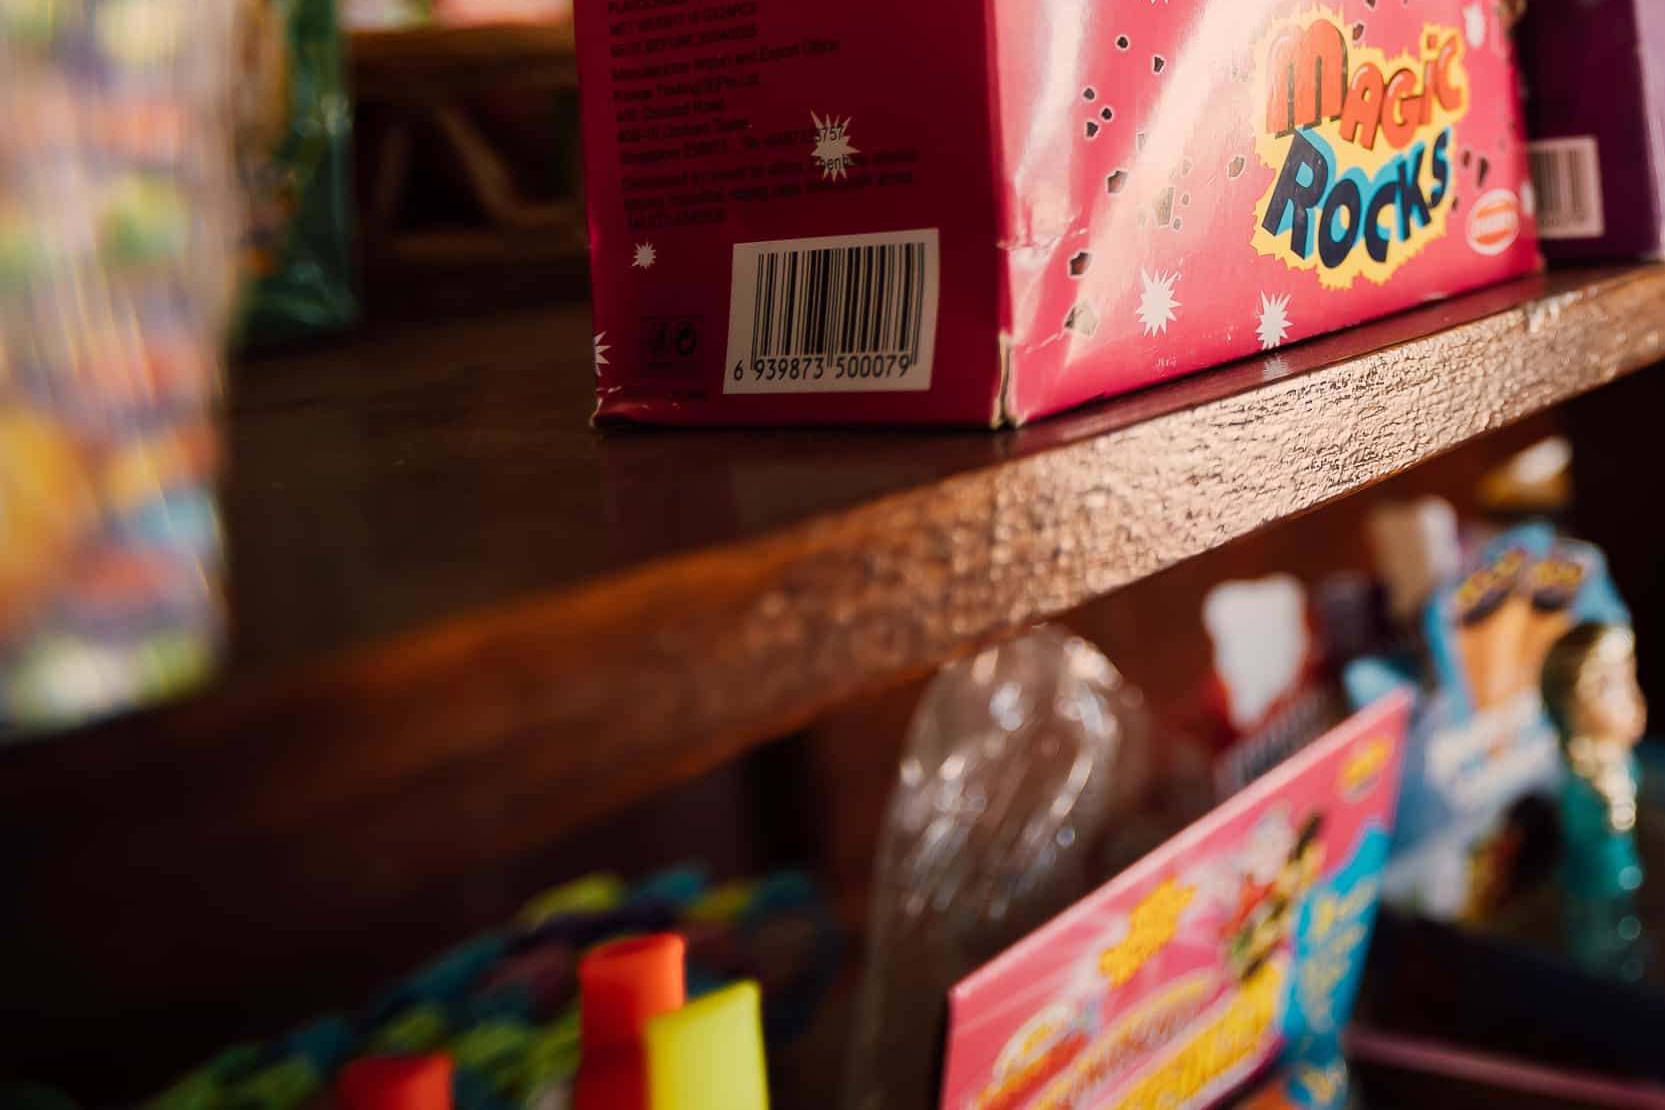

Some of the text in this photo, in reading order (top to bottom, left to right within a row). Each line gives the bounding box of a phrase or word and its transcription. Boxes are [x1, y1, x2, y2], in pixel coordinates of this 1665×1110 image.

[1260, 126, 1452, 269] ROCKS
[733, 353, 911, 382] 6 939873 500079
